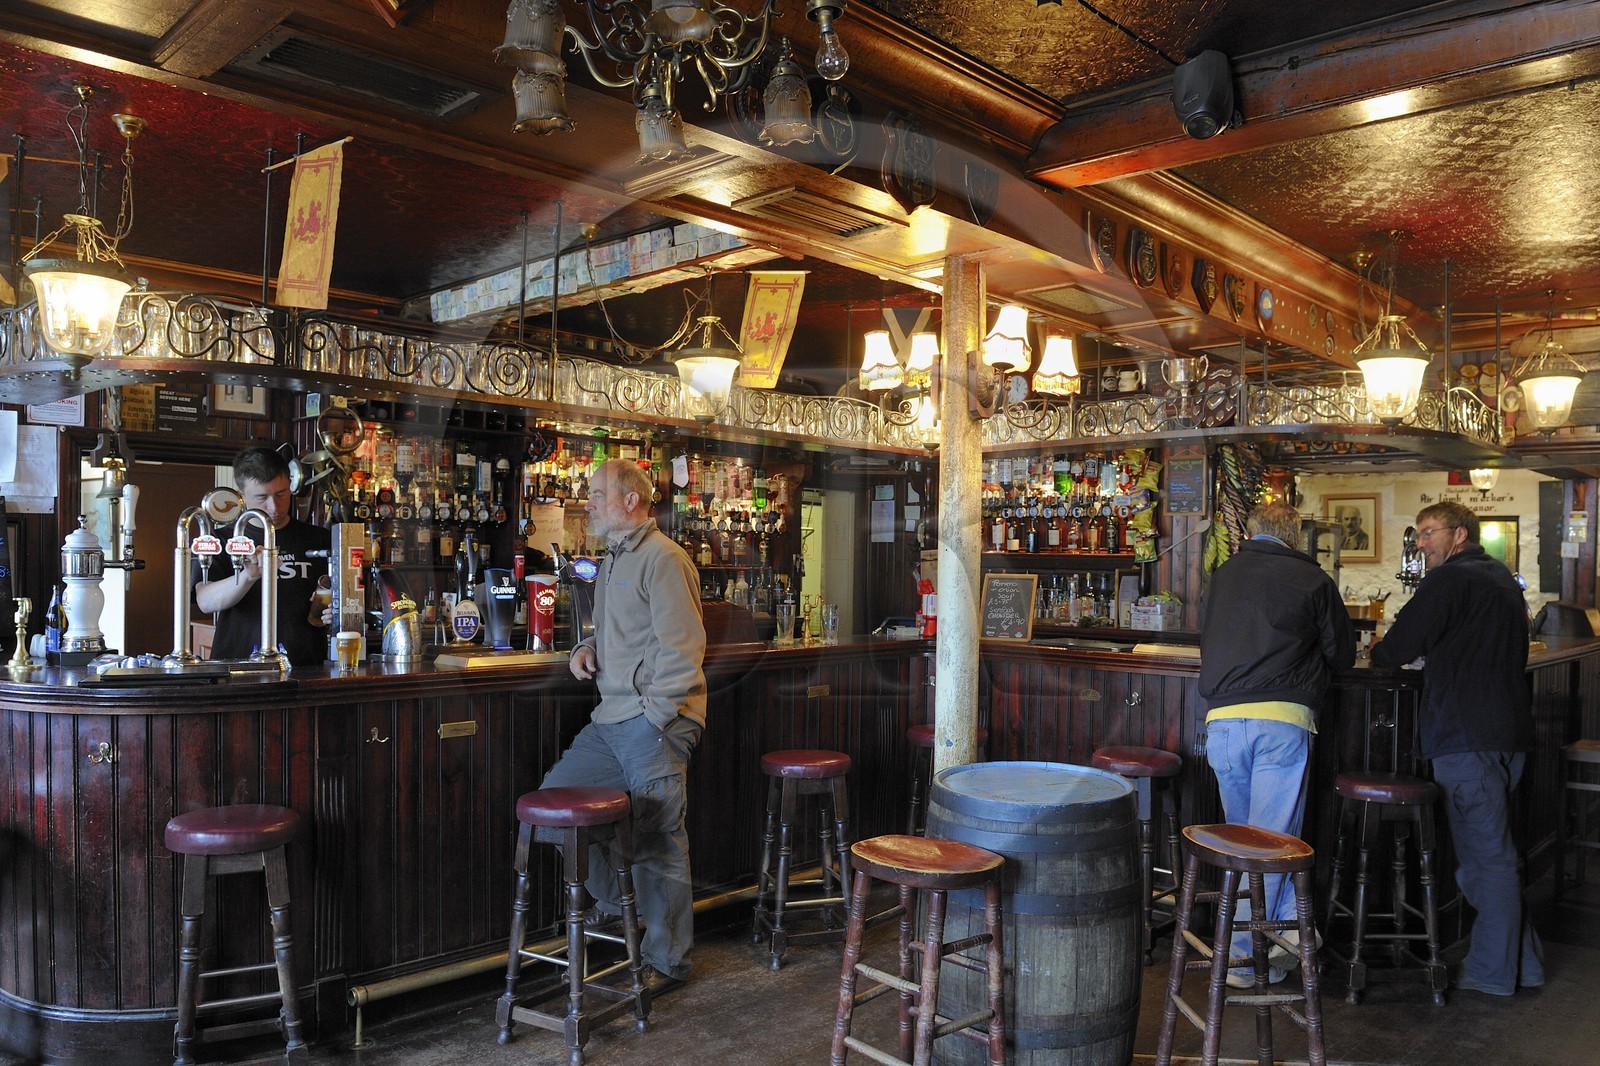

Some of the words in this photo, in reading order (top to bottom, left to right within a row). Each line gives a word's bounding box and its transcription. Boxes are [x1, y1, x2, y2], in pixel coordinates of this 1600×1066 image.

[277, 562, 312, 579] ST
[574, 565, 597, 573] BEST
[456, 617, 476, 627] IPA
